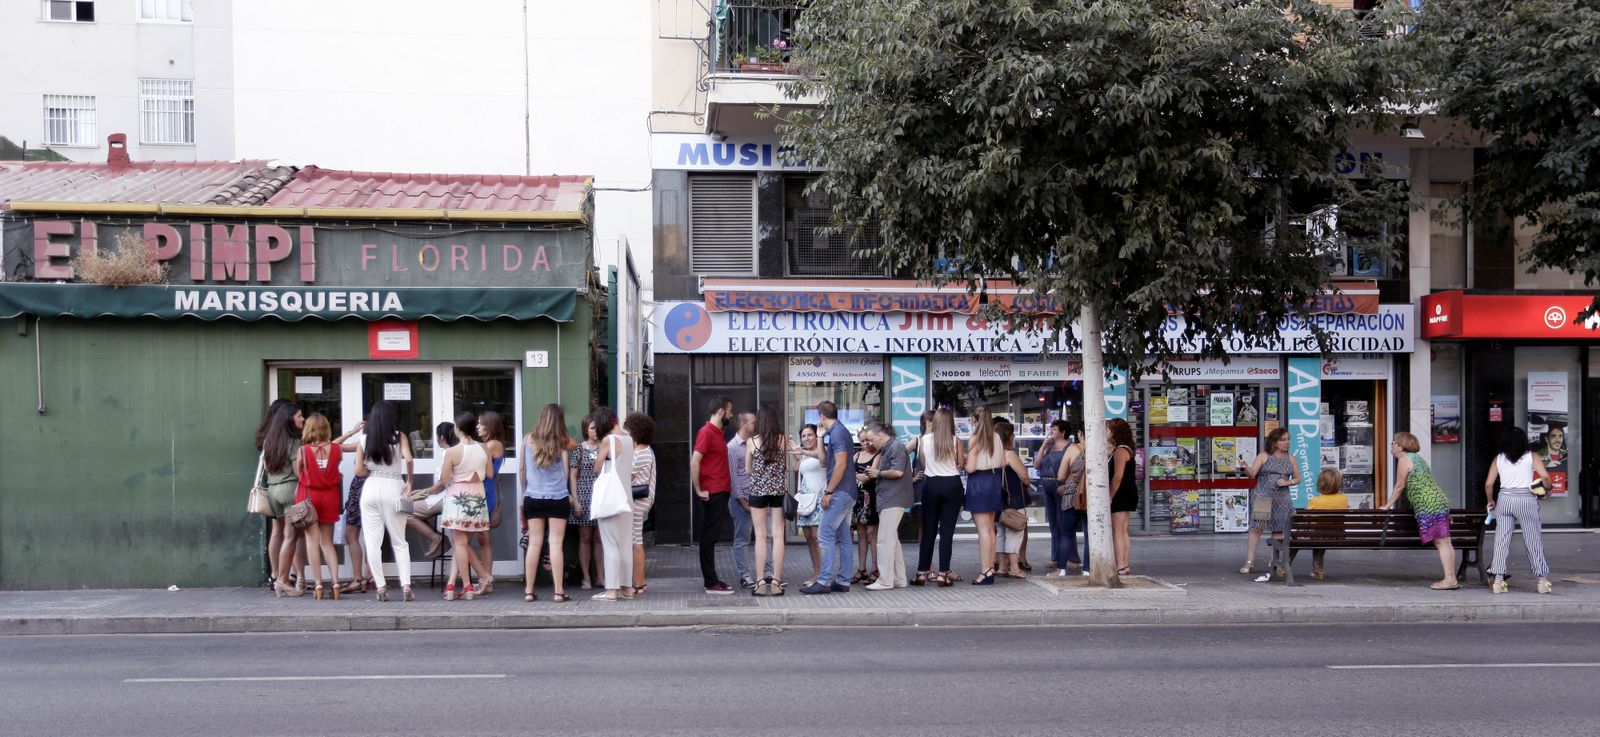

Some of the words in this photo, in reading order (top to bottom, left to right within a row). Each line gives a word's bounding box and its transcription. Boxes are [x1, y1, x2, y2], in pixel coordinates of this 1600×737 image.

[143, 222, 315, 282] PIMPI
[361, 243, 551, 272] FLORIDA
[174, 290, 404, 313] MARISQUERIA
[1305, 309, 1405, 331] REPARACIÓN
[1429, 314, 1448, 324] MAPFRE
[728, 333, 868, 352] ELECTRÓNICA
[886, 333, 1022, 352] INFORMÁTICA
[531, 352, 544, 364] 13
[979, 368, 1011, 377] telecom
[1208, 367, 1244, 376] Mepamsa
